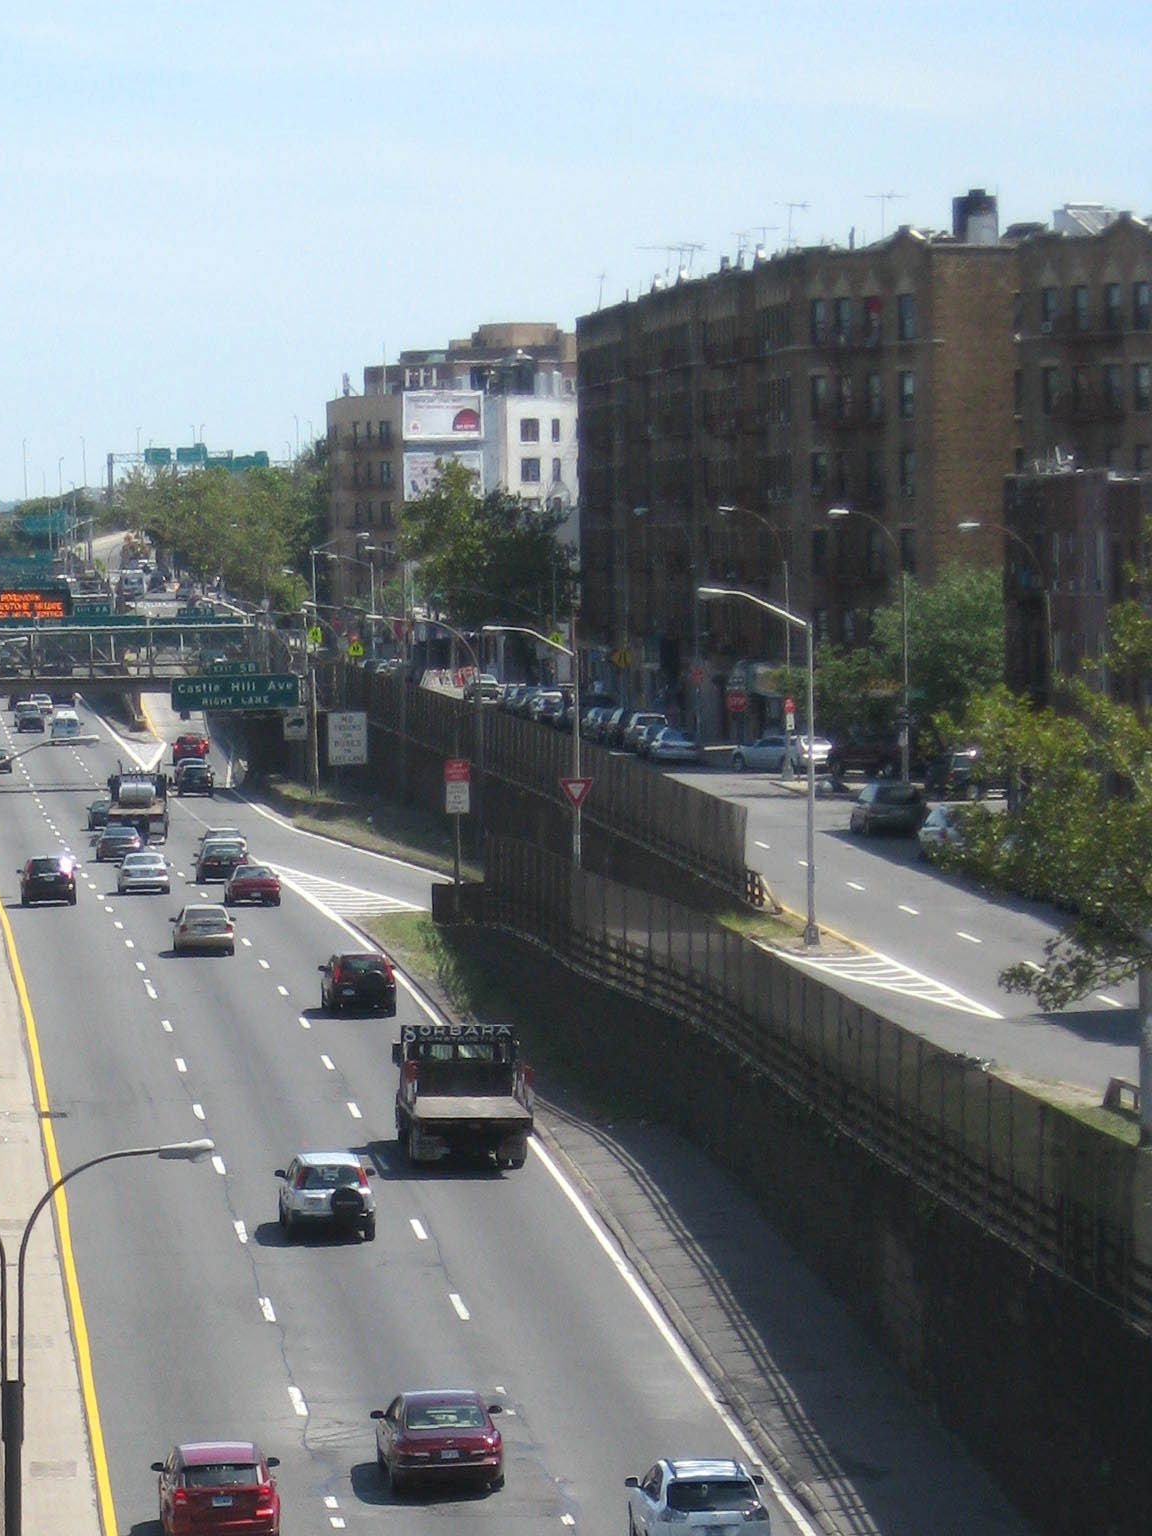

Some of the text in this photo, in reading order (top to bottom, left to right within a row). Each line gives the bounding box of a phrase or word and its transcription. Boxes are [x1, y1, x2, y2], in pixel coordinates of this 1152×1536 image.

[178, 680, 293, 694] Castle Hill Ave
[202, 696, 269, 706] RIGHT LANE
[403, 1025, 511, 1043] SORBARA
